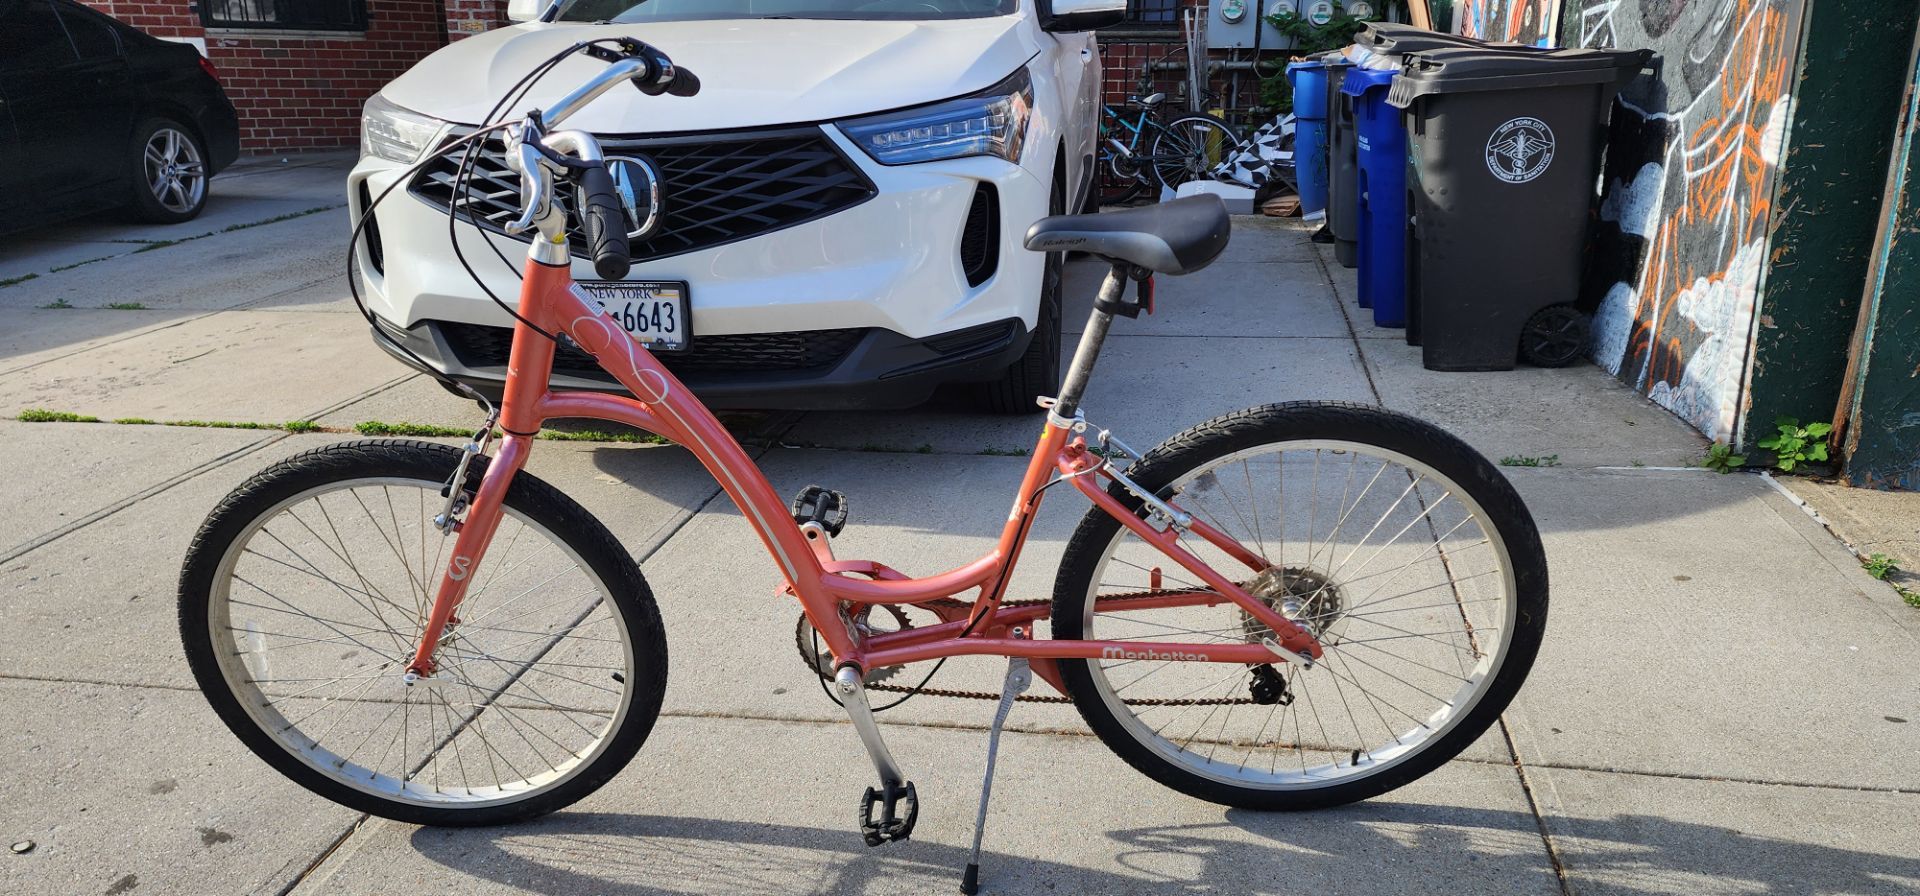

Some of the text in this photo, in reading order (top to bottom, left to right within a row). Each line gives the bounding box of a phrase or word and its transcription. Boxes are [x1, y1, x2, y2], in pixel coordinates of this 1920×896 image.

[1500, 122, 1514, 133] NEW
[1533, 122, 1546, 131] CITY
[1489, 156, 1514, 181] DEPARTMENT
[1523, 153, 1551, 179] SANITATION
[589, 288, 652, 299] NEW YORK
[623, 301, 675, 333] 6643
[1103, 646, 1209, 662] Manhattan
